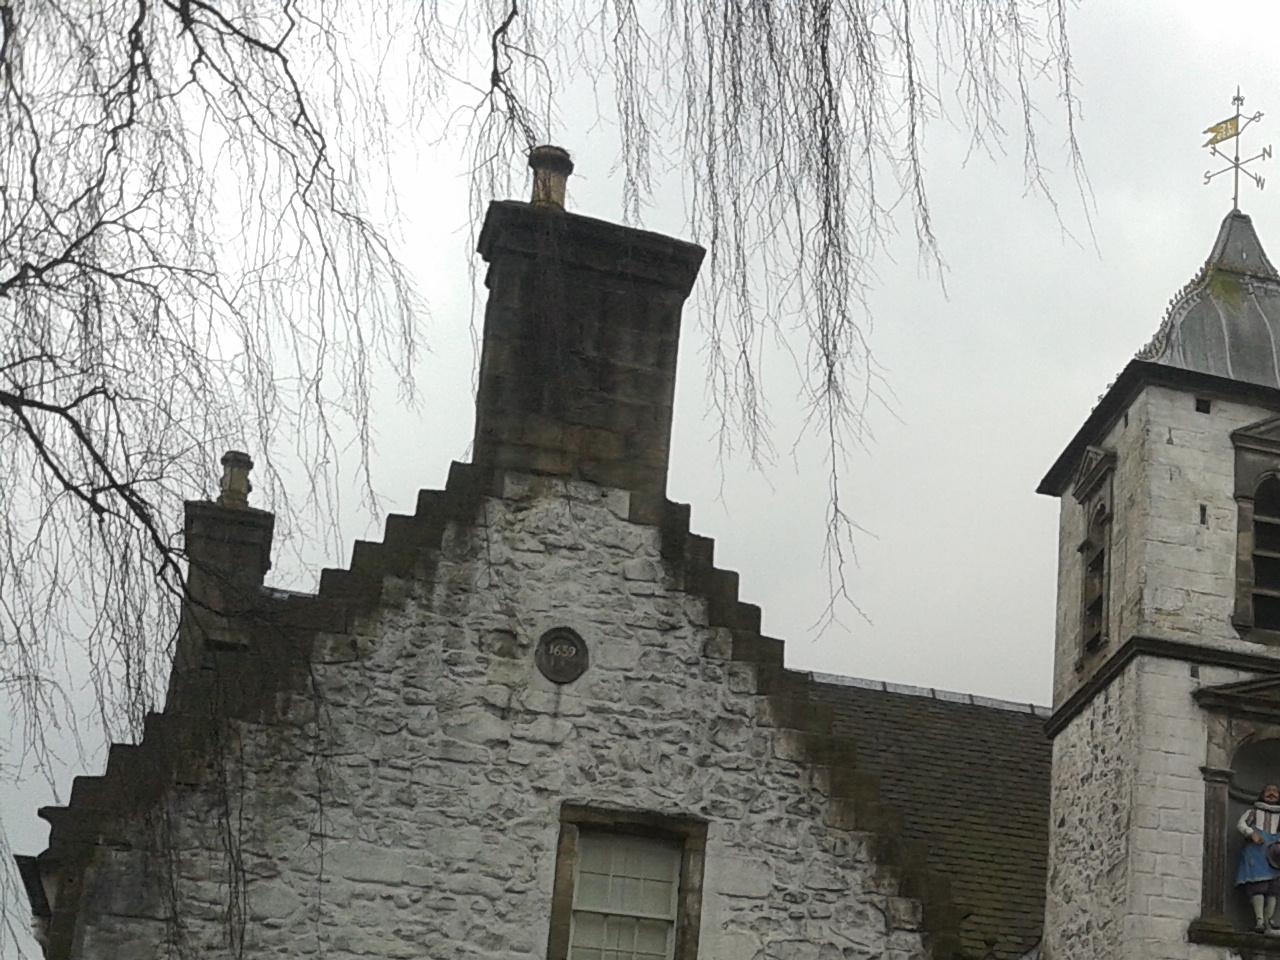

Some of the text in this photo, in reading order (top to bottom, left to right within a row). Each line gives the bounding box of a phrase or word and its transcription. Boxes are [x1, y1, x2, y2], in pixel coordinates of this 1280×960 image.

[1262, 144, 1272, 161] N
[1203, 170, 1211, 185] S
[1254, 172, 1265, 190] W
